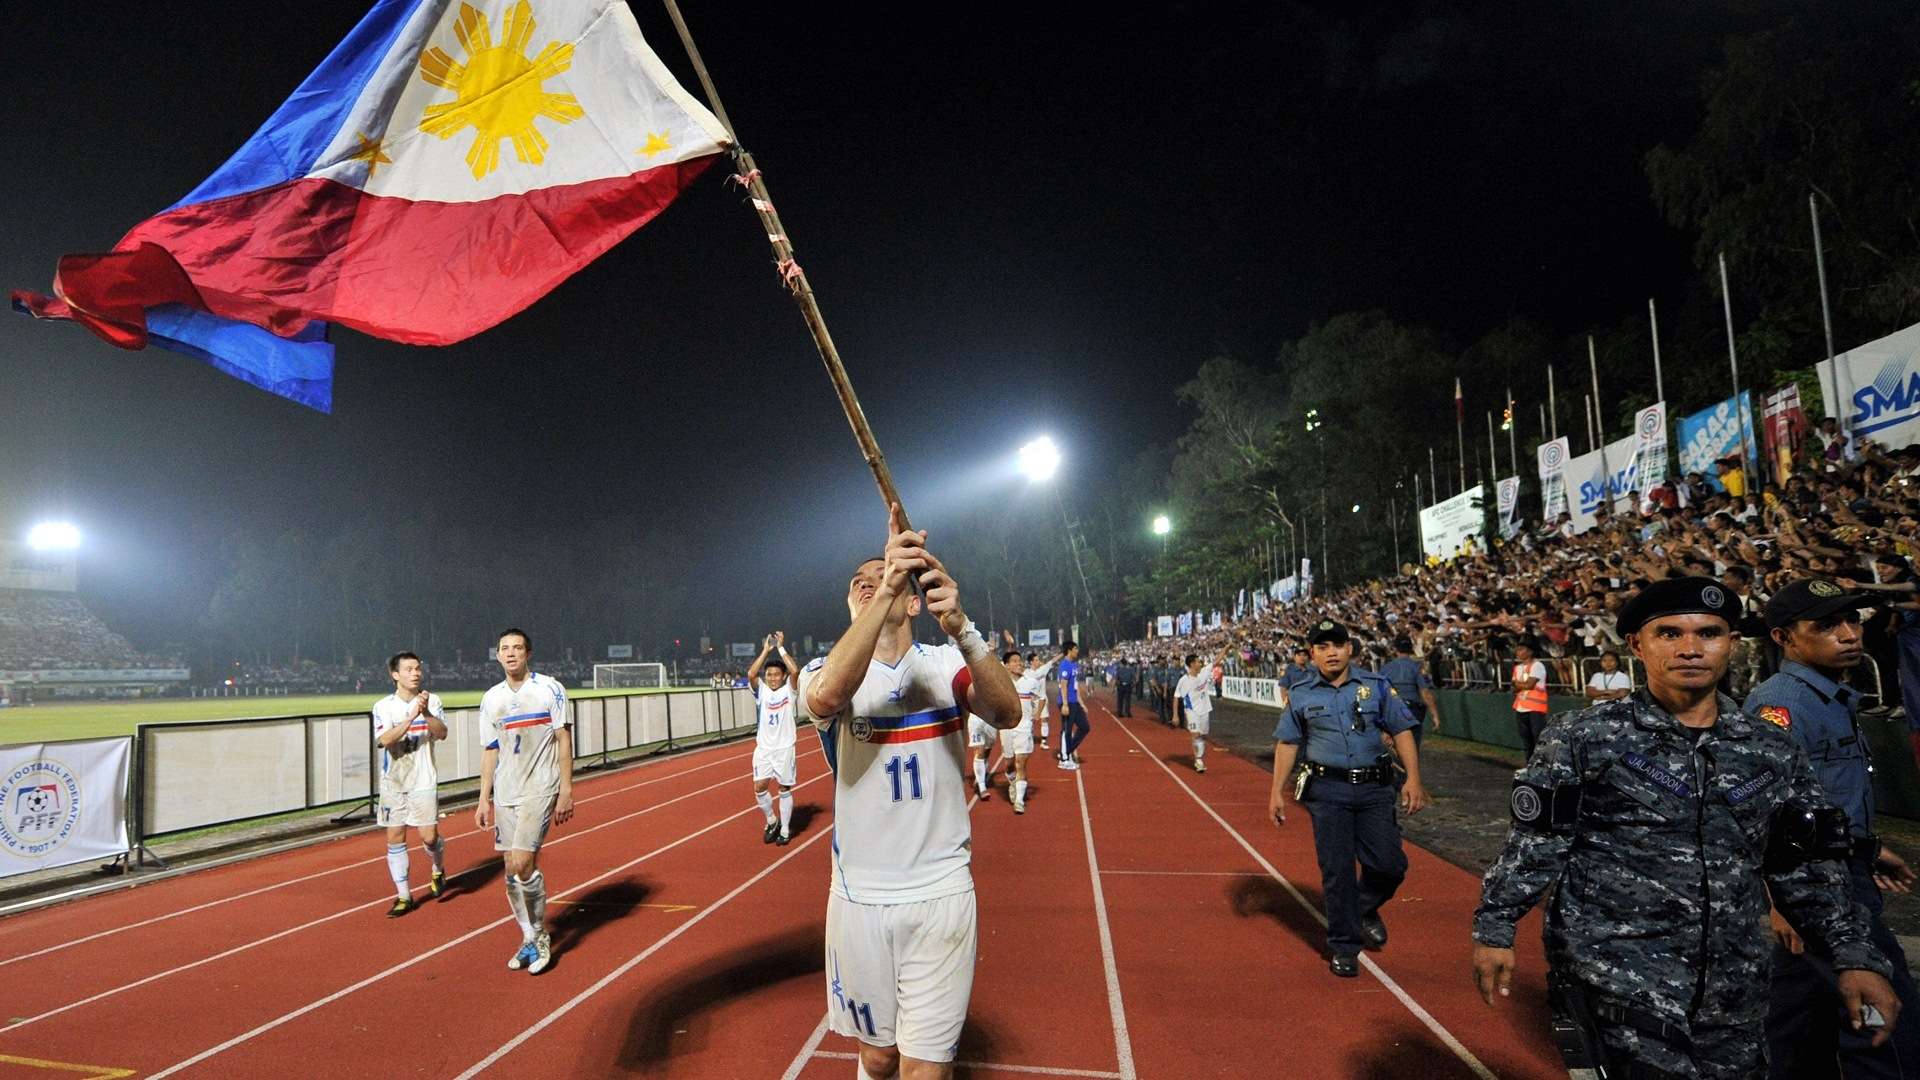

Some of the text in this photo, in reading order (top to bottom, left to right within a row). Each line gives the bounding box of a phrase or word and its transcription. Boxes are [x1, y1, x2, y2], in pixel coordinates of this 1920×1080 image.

[1256, 681, 1276, 702] PARK
[768, 713, 780, 726] 21
[513, 734, 522, 755] 2
[885, 752, 923, 803] 11
[1627, 756, 1682, 796] JALANDOON
[0, 762, 80, 848] PHILNE FOOTBALL FEDERATION
[18, 810, 62, 833] PFF
[28, 842, 49, 854] 1907
[847, 998, 877, 1037] 11
